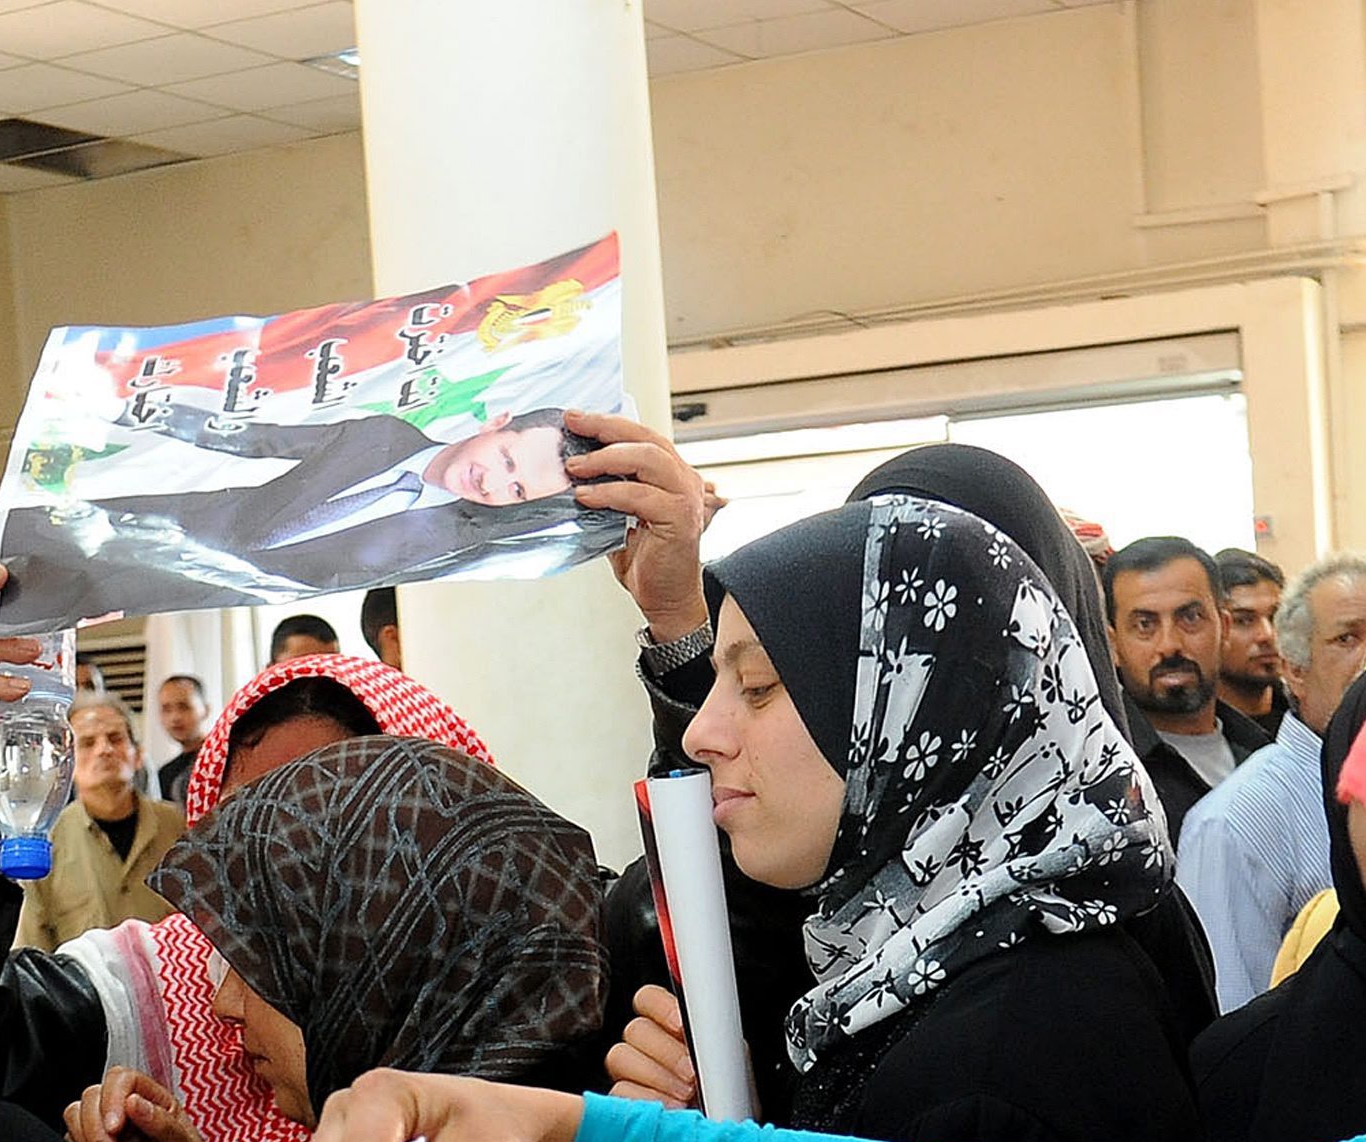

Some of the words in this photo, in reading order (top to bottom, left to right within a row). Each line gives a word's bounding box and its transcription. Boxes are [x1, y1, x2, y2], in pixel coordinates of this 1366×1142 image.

[398, 305, 451, 374] اخترت
[208, 350, 270, 431] والشعب
[307, 340, 357, 411] الشعب
